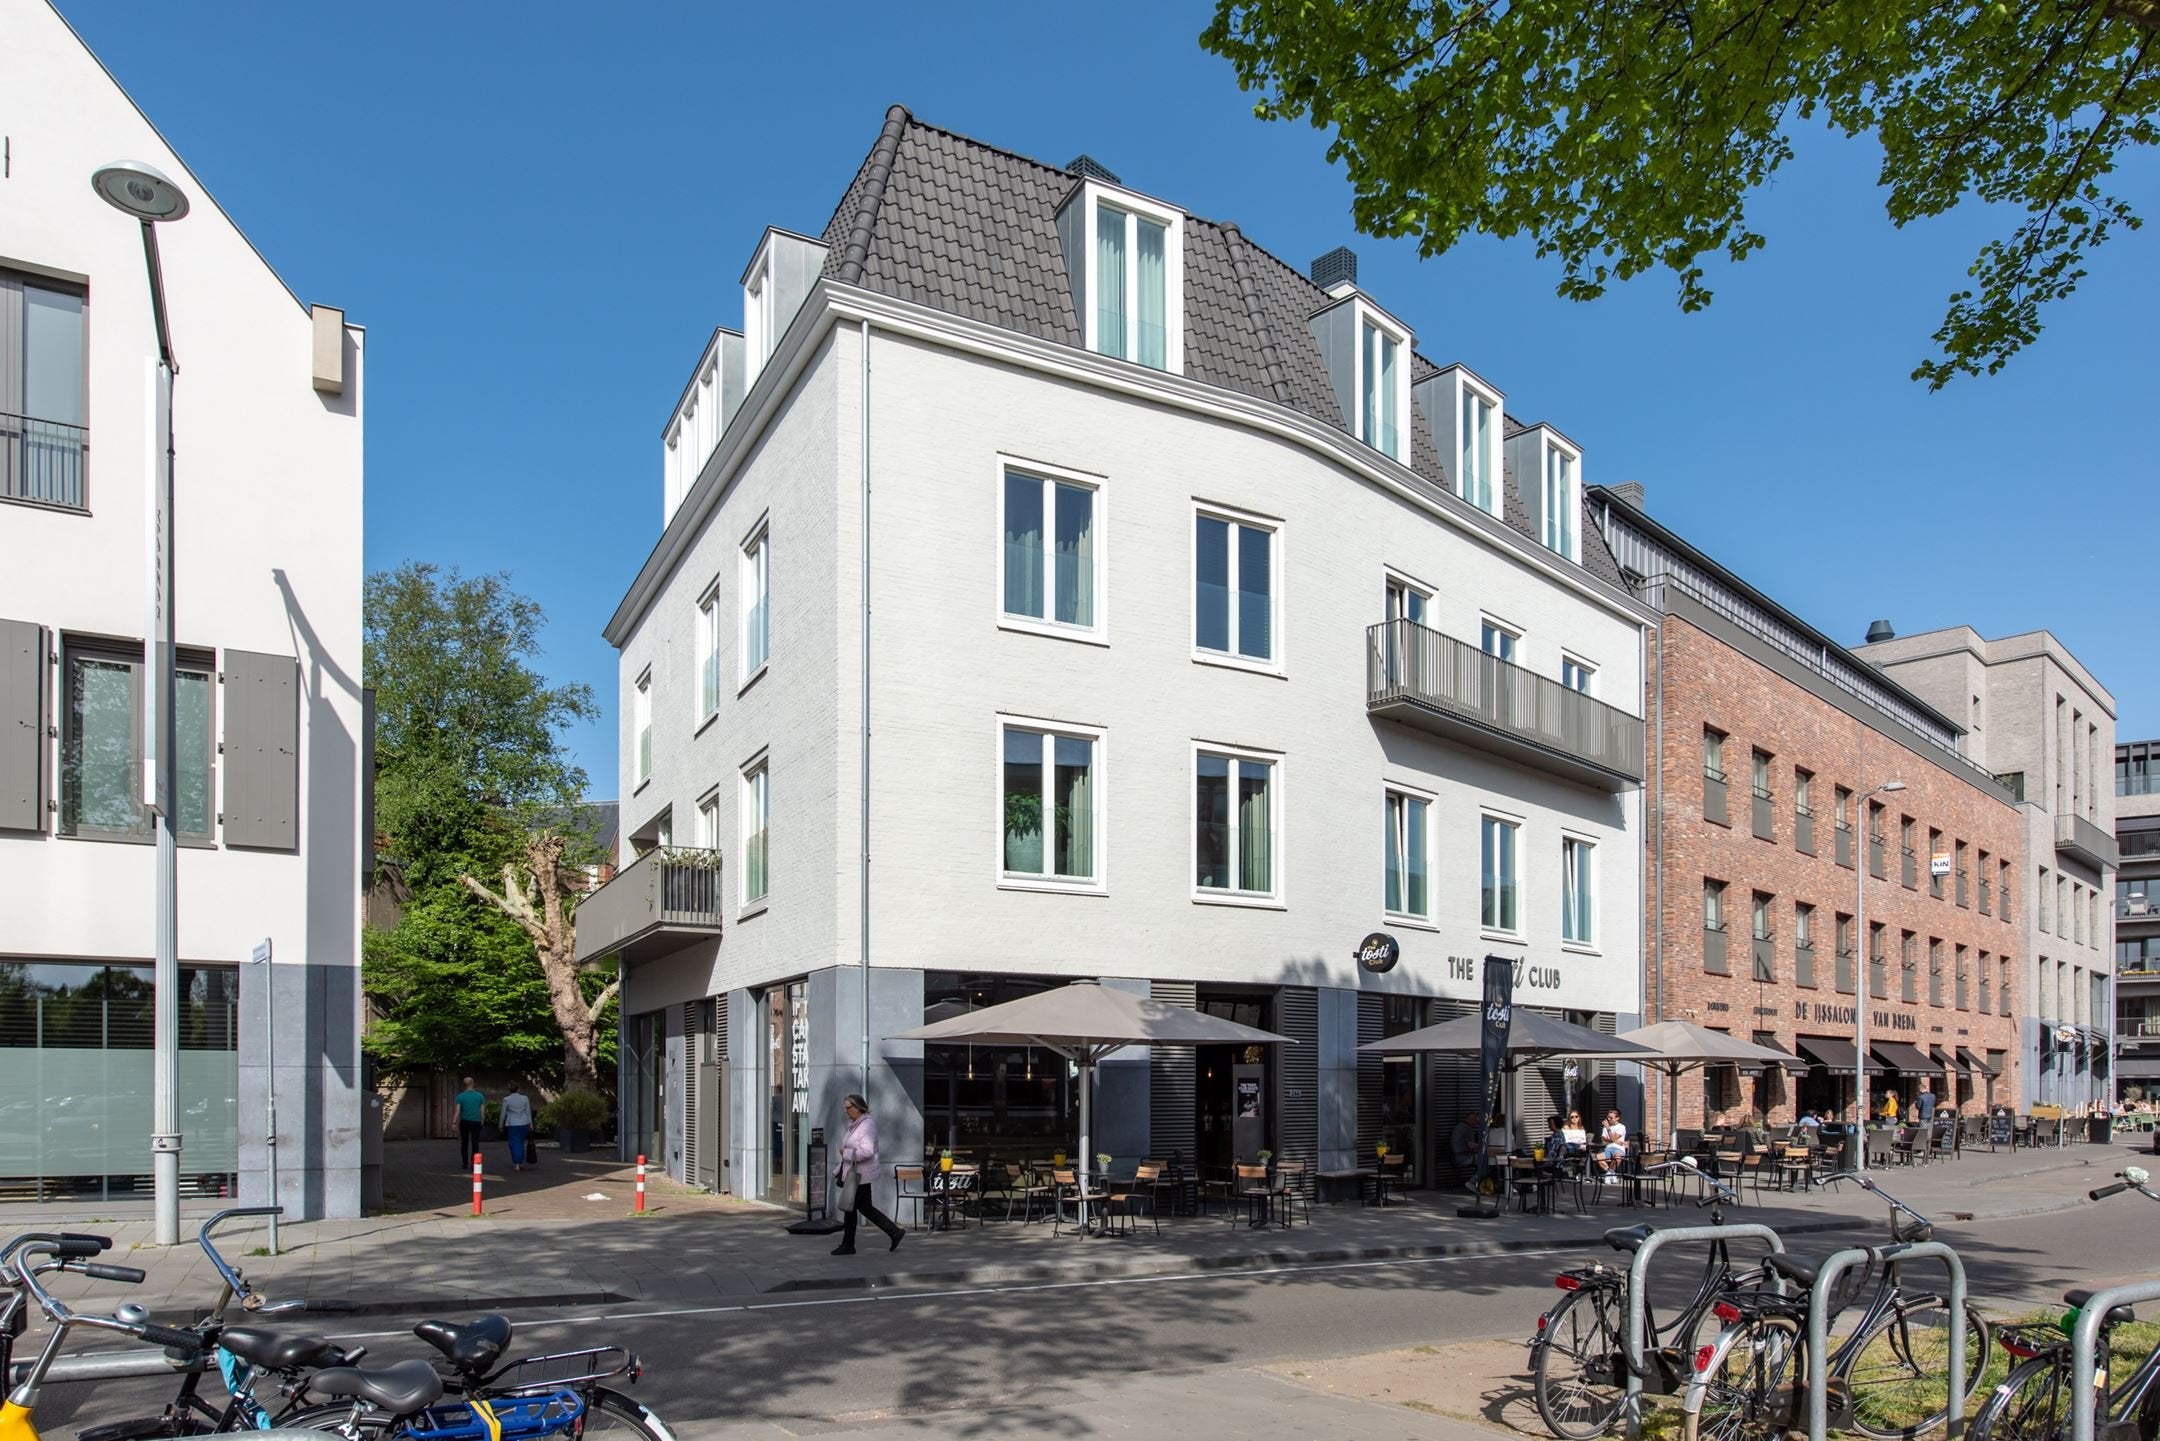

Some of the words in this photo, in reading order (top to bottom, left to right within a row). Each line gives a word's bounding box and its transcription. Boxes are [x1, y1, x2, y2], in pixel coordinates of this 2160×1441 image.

[1361, 943, 1389, 961] tosti
[1447, 955, 1474, 981] THE
[1528, 966, 1561, 990] CLUB
[1795, 1000, 1808, 1021] DE
[1873, 1010, 1889, 1029] VAN
[1892, 1012, 1917, 1031] BREDA
